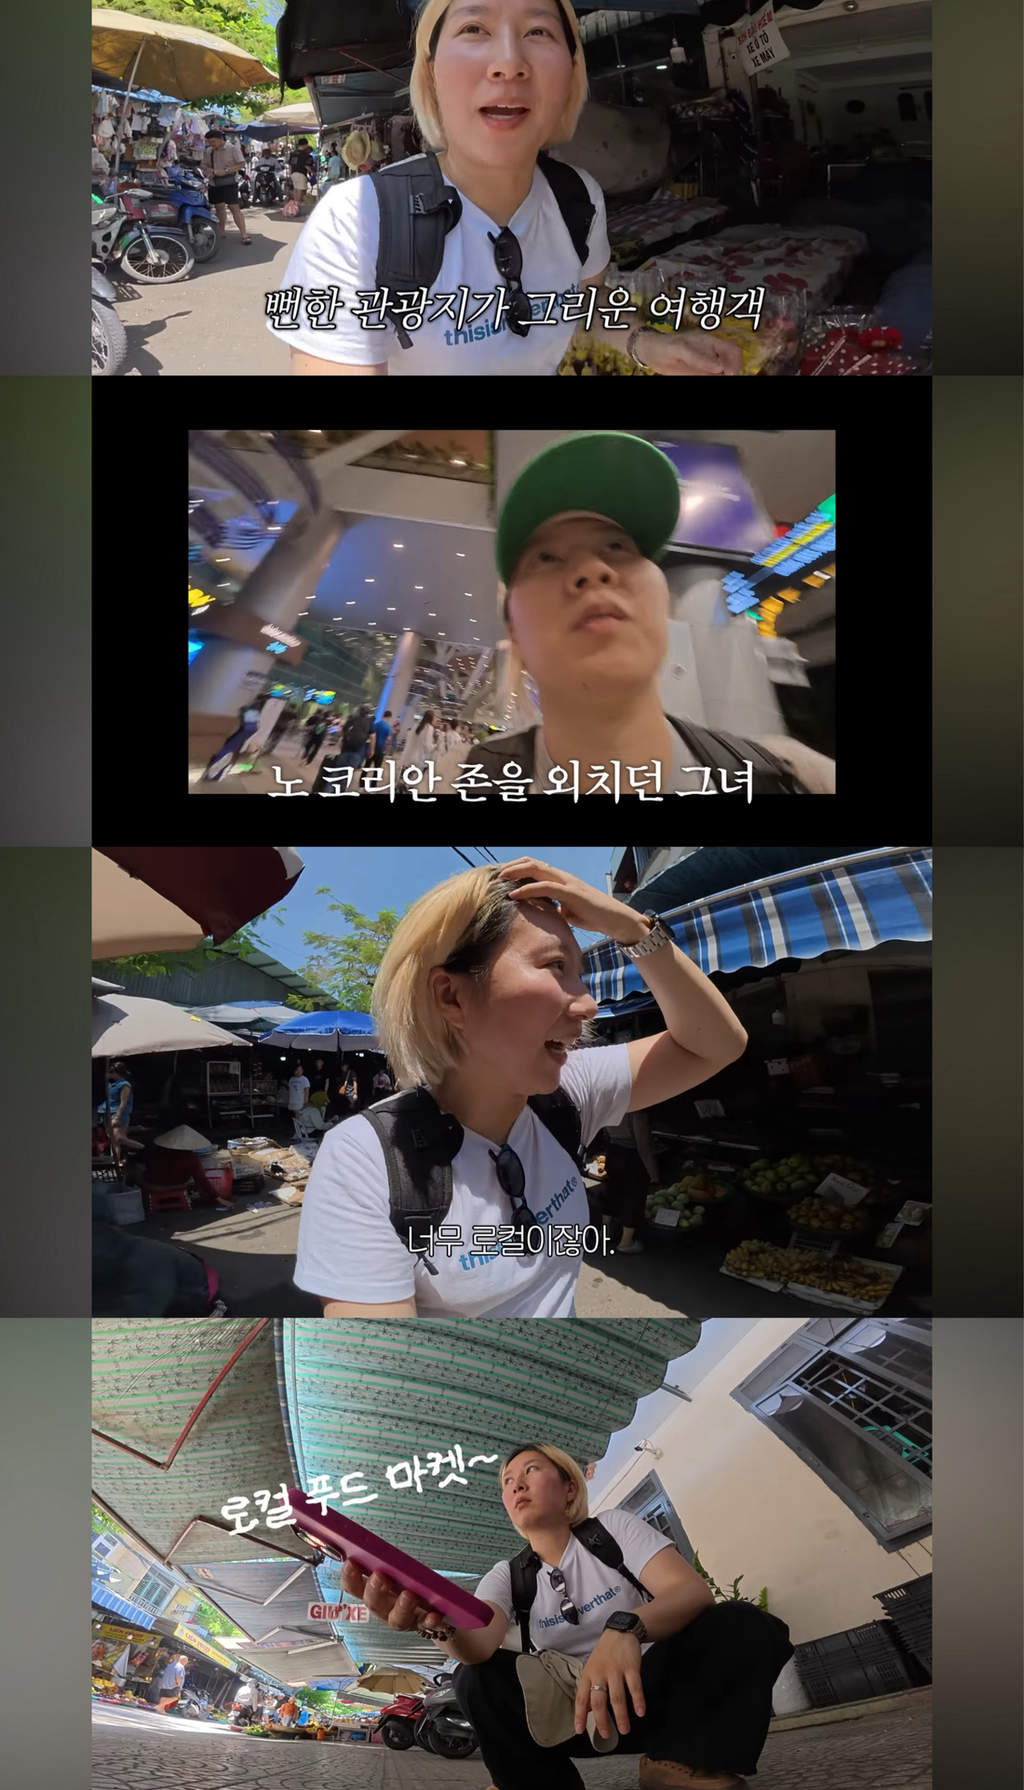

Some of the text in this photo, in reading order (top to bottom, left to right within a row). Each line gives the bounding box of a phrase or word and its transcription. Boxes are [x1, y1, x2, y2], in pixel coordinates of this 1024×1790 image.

[746, 41, 755, 55] XE
[751, 46, 775, 68] XE MÁY
